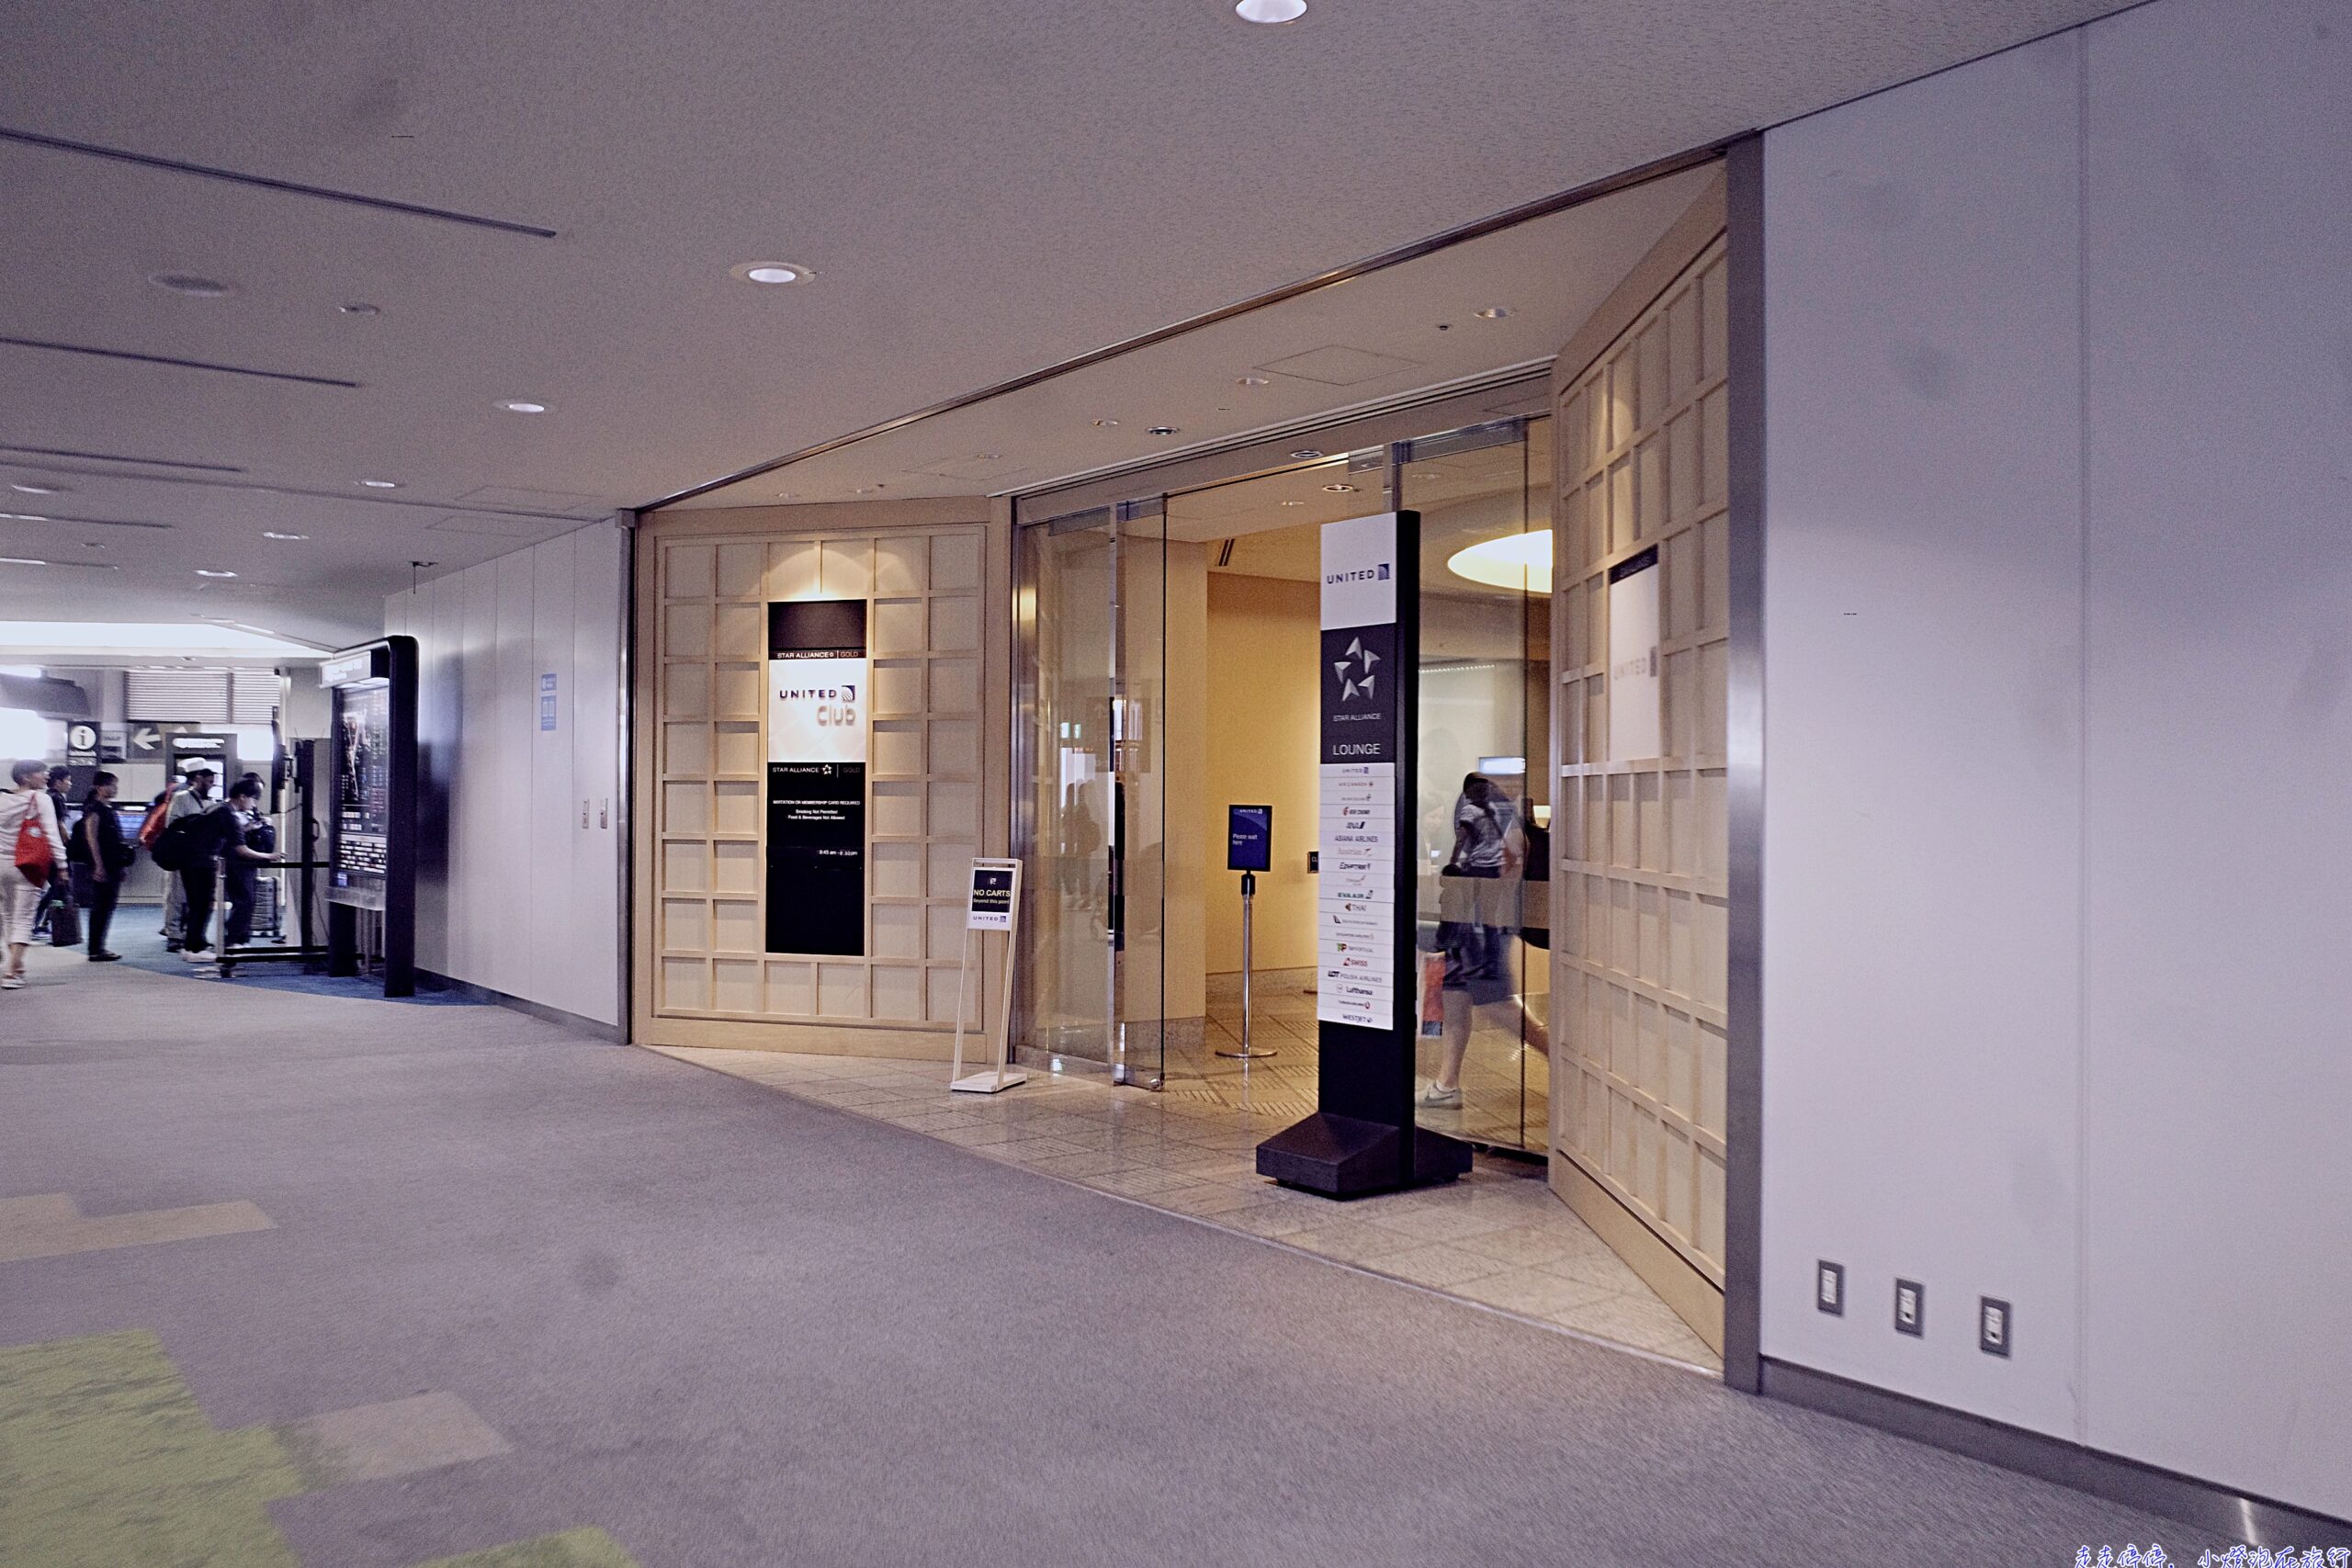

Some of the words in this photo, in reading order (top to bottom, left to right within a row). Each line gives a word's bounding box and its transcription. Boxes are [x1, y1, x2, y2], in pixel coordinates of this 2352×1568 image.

[1327, 570, 1375, 584] UNITED
[780, 690, 837, 698] UNITED
[817, 704, 856, 726] Club
[1351, 713, 1381, 721] ALLIANCE
[1333, 743, 1381, 756] LOUNGE
[1346, 986, 1373, 995] Lufthansa
